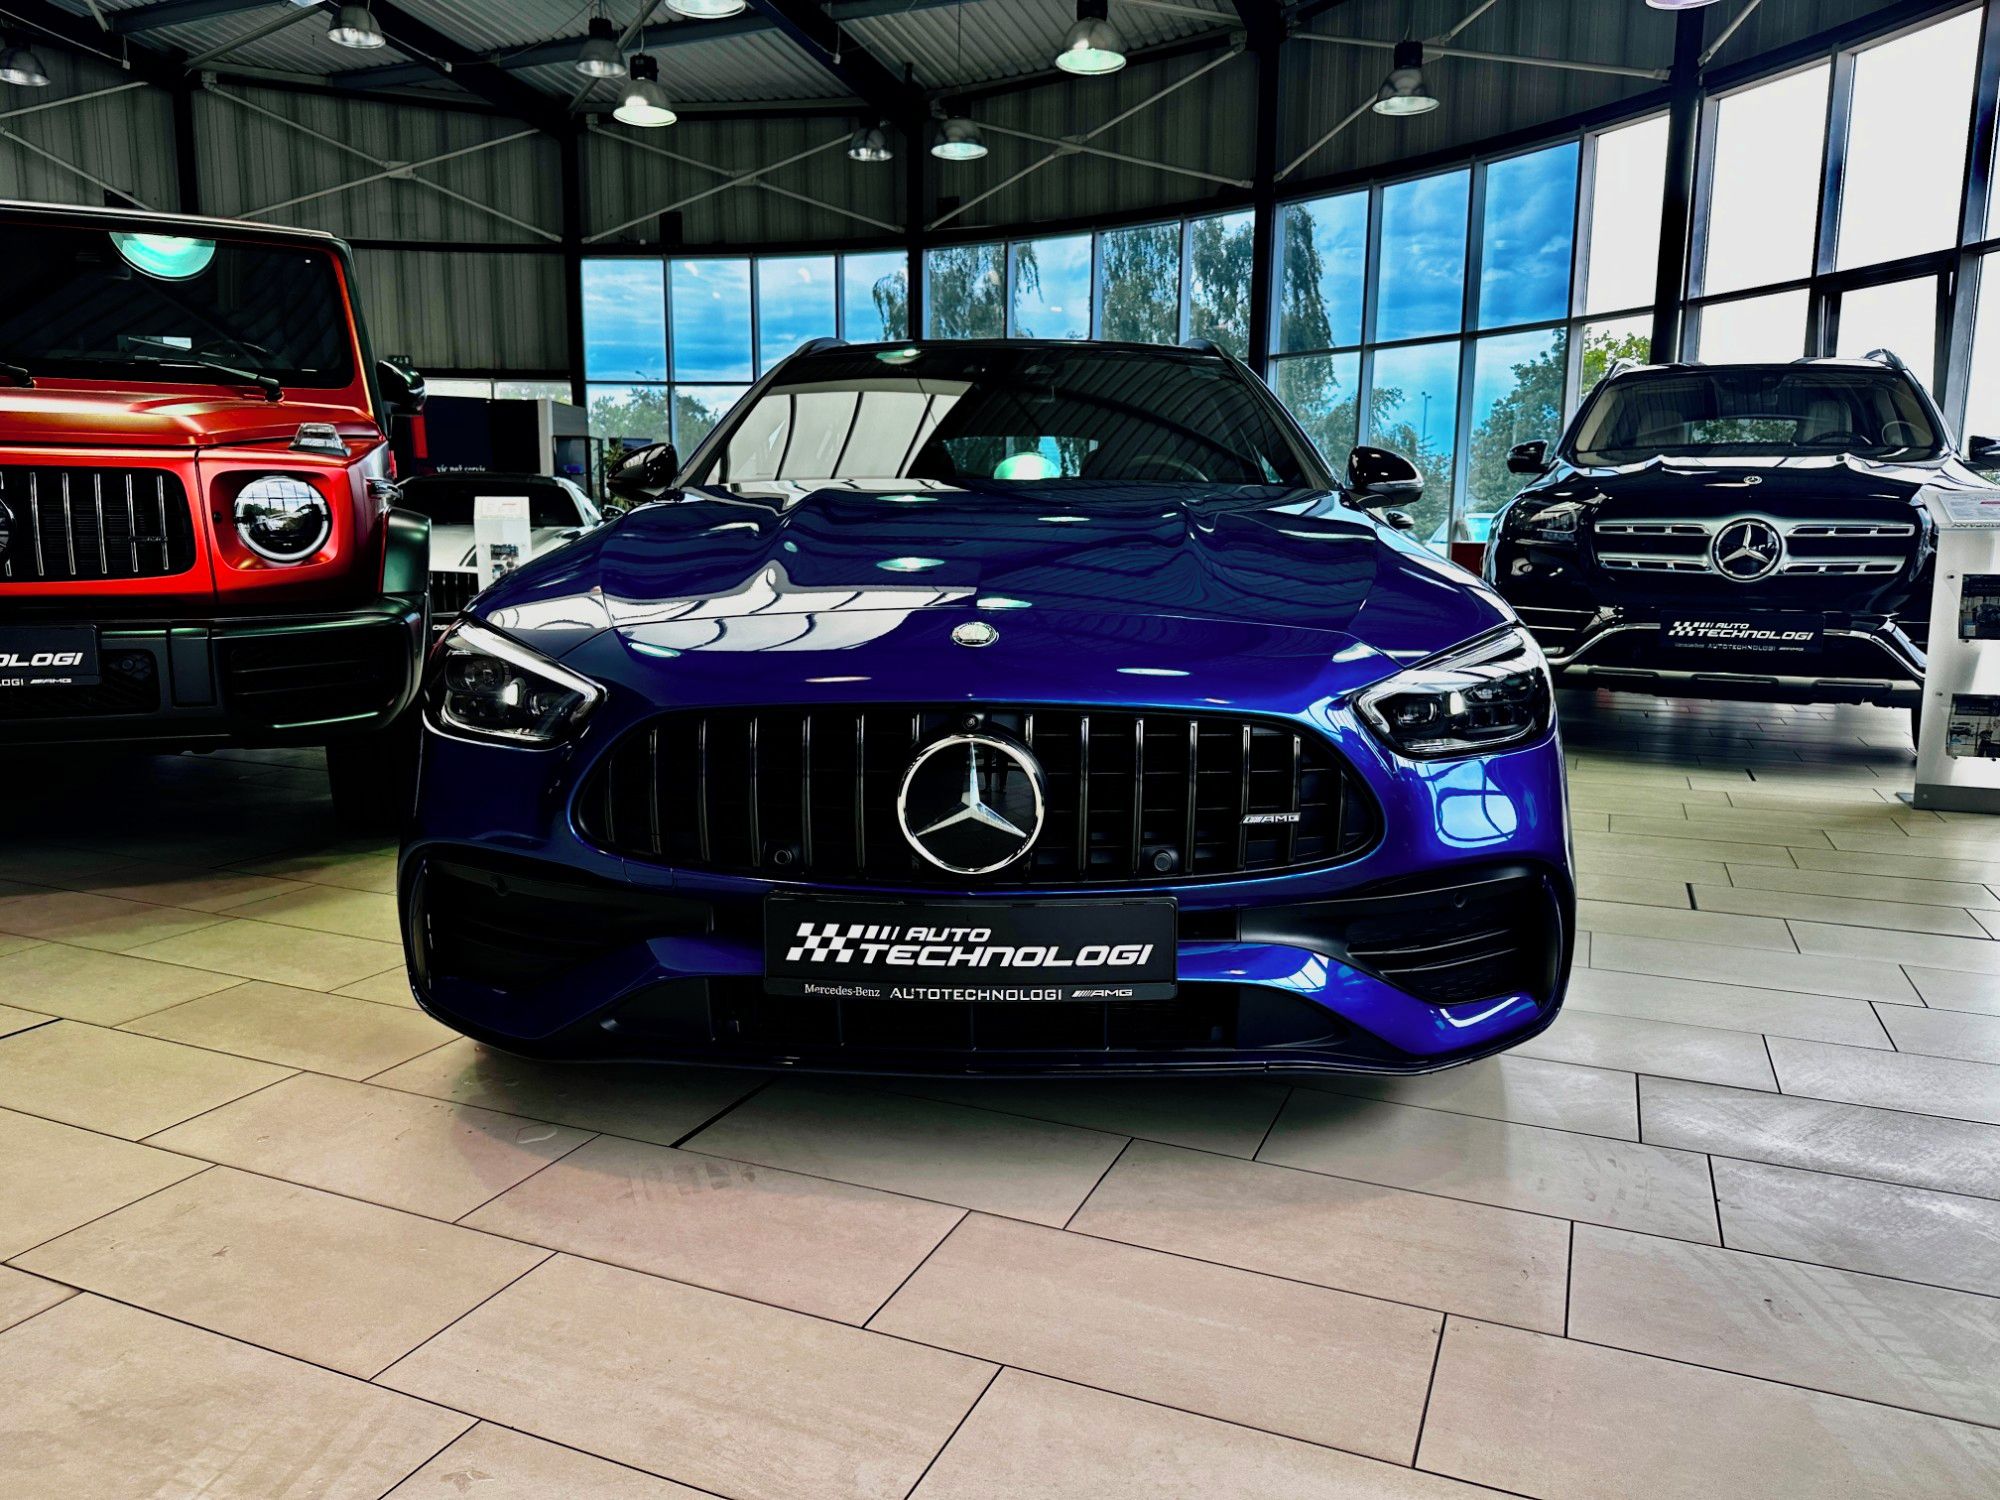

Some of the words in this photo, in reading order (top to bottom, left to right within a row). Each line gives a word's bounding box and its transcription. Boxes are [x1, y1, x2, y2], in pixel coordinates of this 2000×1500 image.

[1697, 628, 1815, 641] TECHNOLOGI
[1259, 814, 1300, 823] AMG
[904, 926, 992, 942] AUTO
[858, 943, 1154, 967] TECHNOLOGI
[804, 983, 880, 997] Mercedes-Benz
[889, 987, 1062, 1001] AUTOTECHNOLOGI
[1089, 988, 1133, 997] AMG
